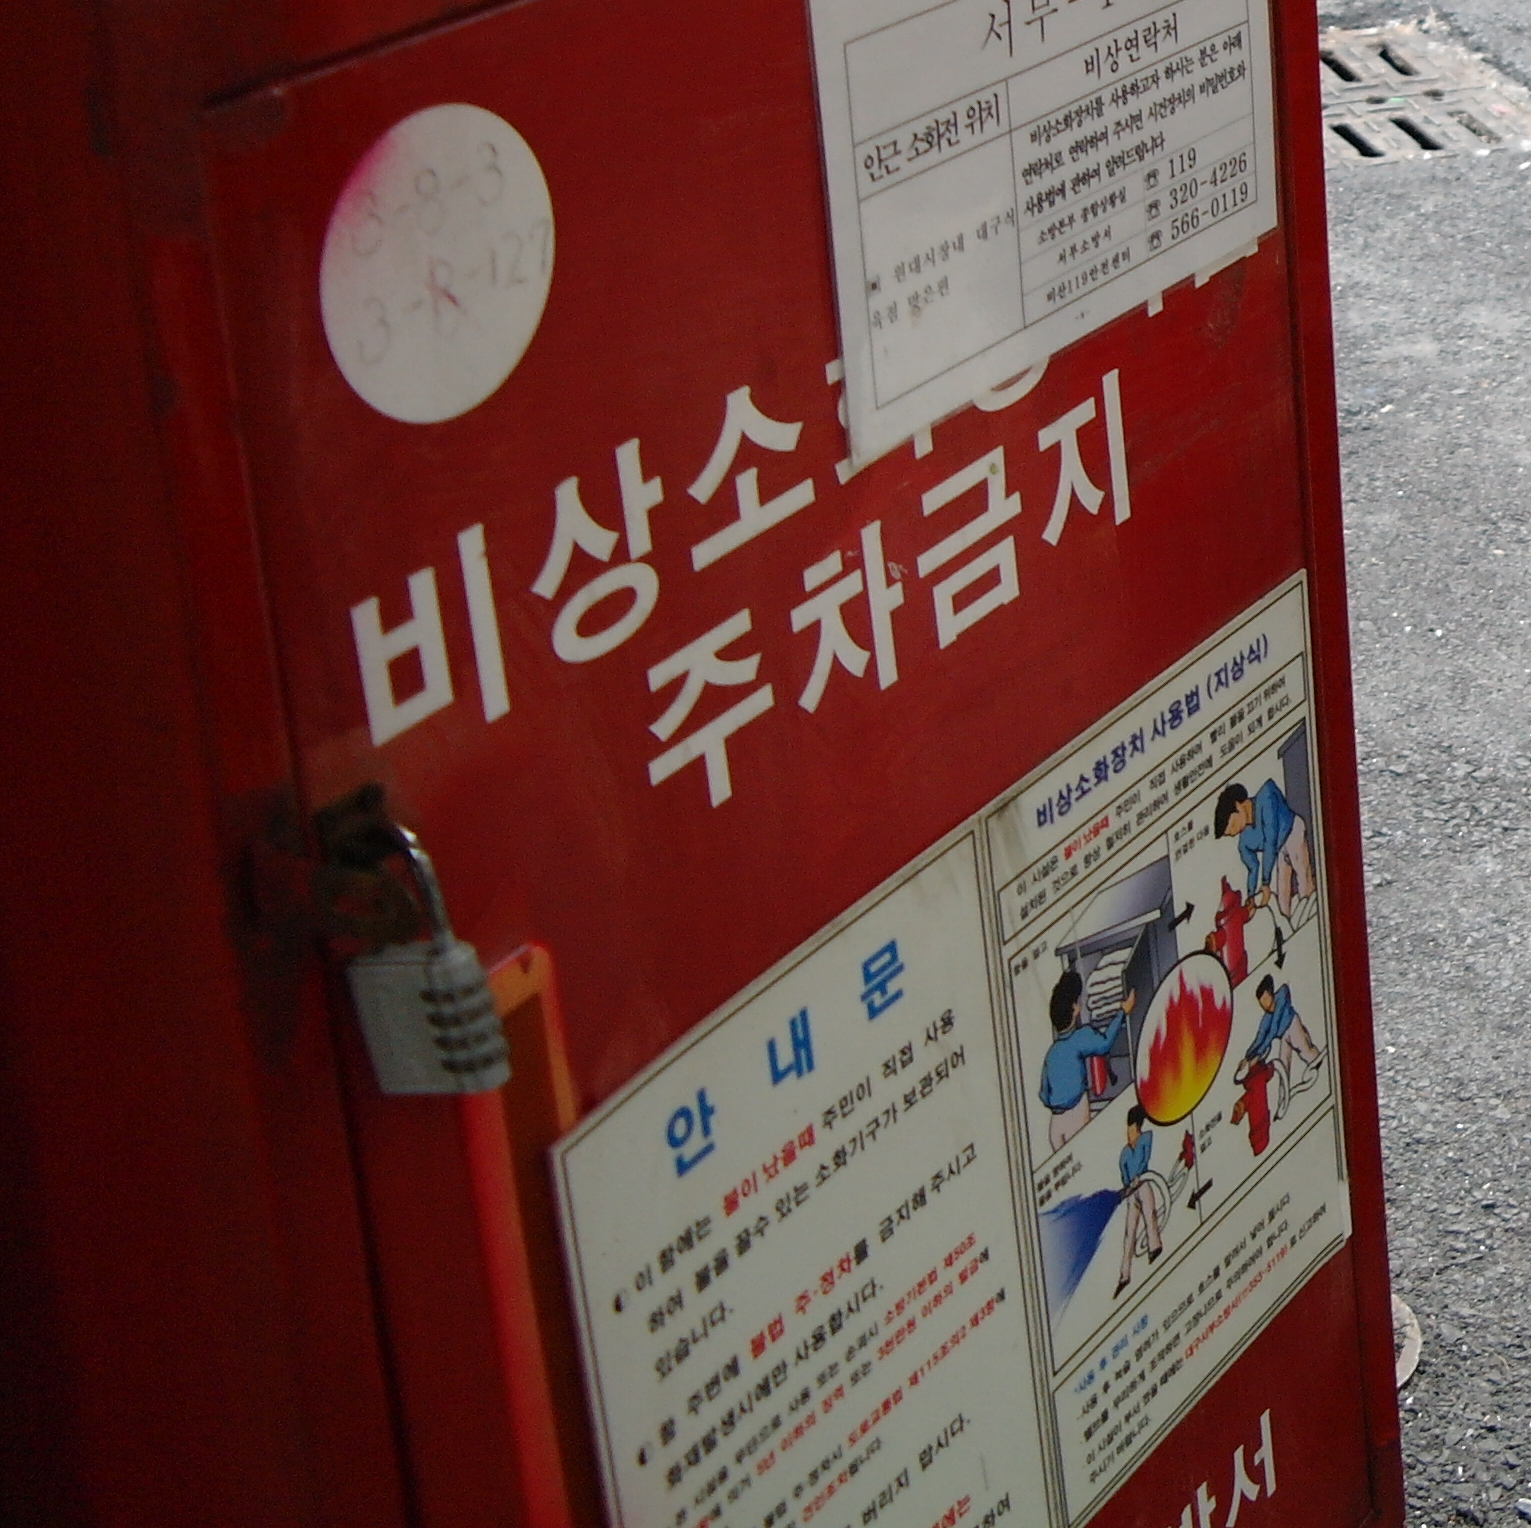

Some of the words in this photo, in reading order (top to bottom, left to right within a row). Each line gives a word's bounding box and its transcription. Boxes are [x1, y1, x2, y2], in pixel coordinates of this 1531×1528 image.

[1083, 11, 1179, 80] 비상연락처
[906, 110, 961, 163] 소화전
[963, 92, 1001, 136] 위치
[1168, 147, 1197, 180] 119
[1168, 151, 1248, 211] 320-4226
[1170, 181, 1249, 241] 566-0119
[648, 369, 1132, 809] 주차금지
[1036, 726, 1145, 829] 비상소화장치
[1150, 684, 1201, 742] 사용법
[1206, 633, 1269, 700] (지상식)
[821, 1075, 872, 1131] 주민이
[881, 1041, 914, 1080] 직접
[924, 1008, 954, 1047] 사용
[814, 1102, 898, 1189] 소화기구가
[902, 1044, 966, 1113] 보관되어
[878, 1185, 928, 1244] 금지해
[929, 1142, 978, 1194] 주시고
